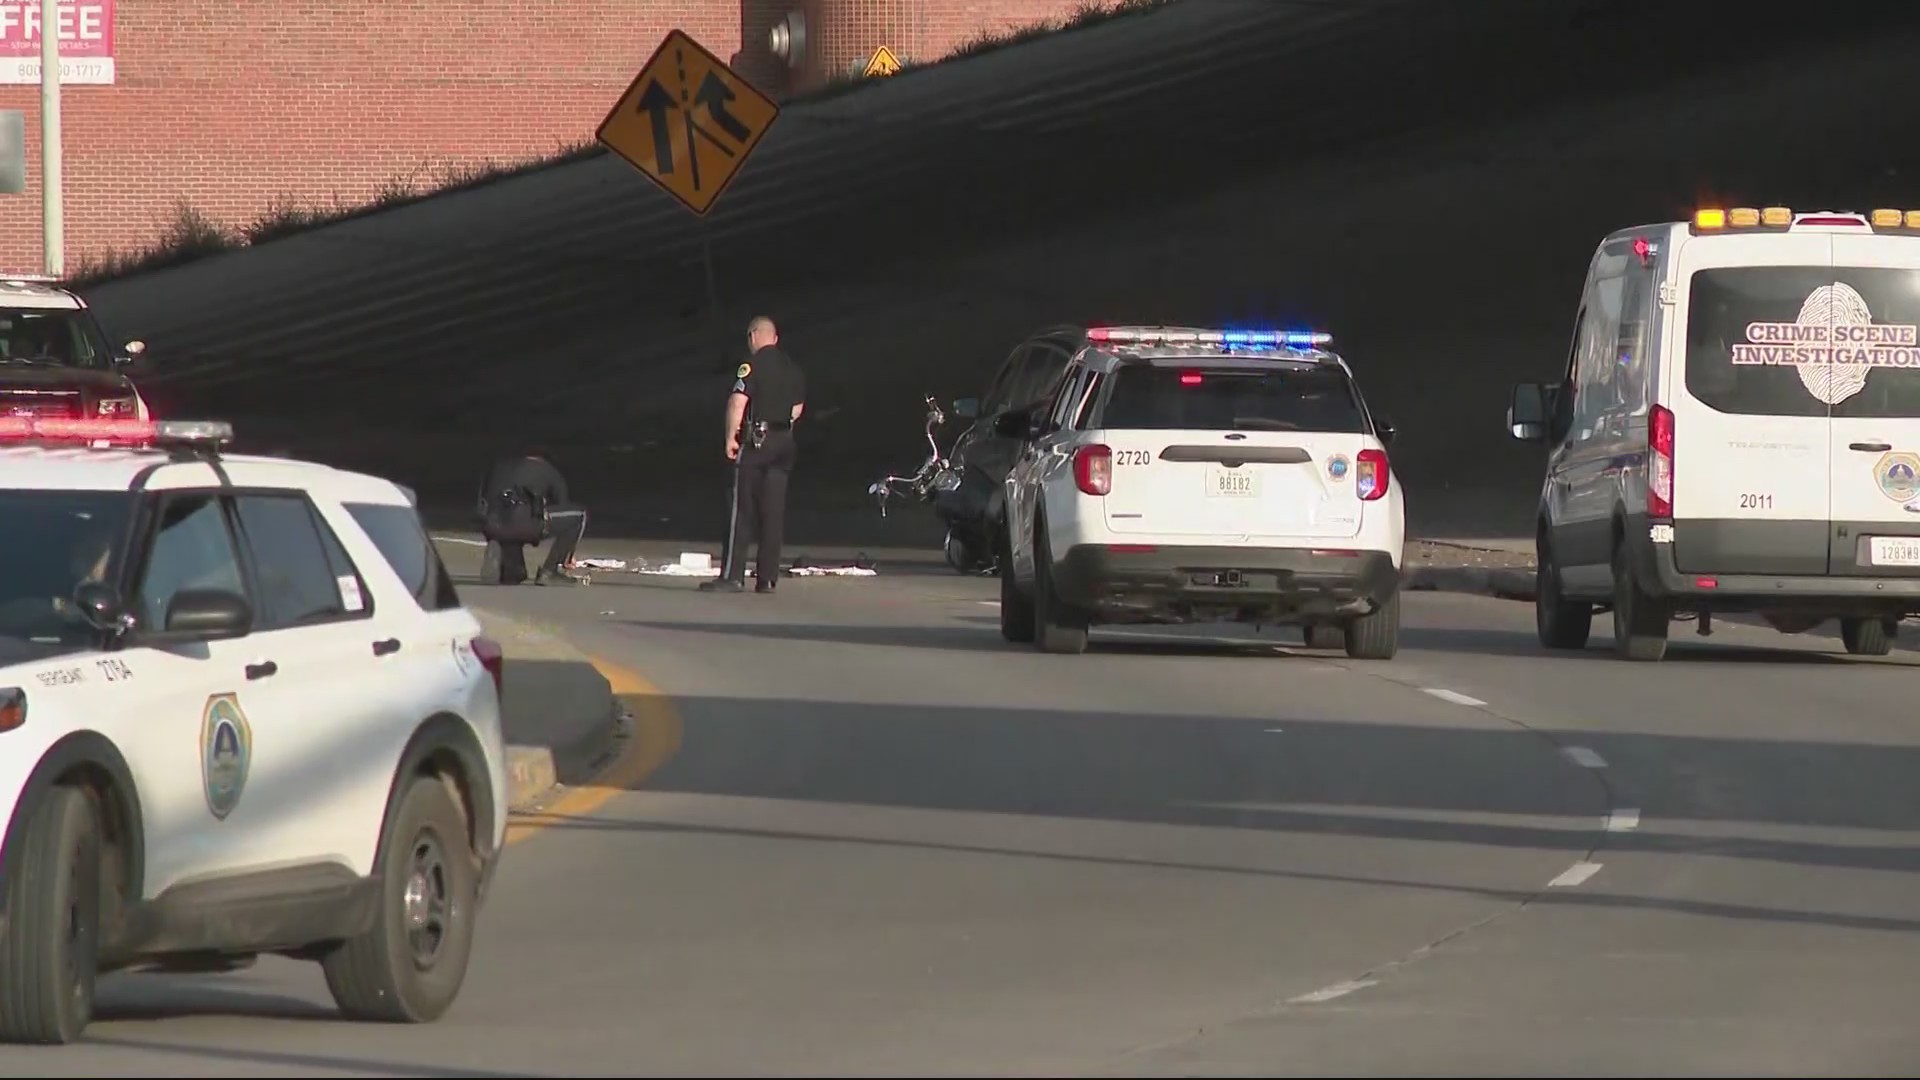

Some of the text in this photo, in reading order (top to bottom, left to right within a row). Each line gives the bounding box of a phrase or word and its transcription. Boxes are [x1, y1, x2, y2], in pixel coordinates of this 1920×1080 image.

[0, 5, 102, 39] FREE
[1749, 325, 1914, 343] CRIME SCENE
[1117, 450, 1150, 465] 2720
[1220, 476, 1250, 490] 88182
[1740, 493, 1772, 509] 2011
